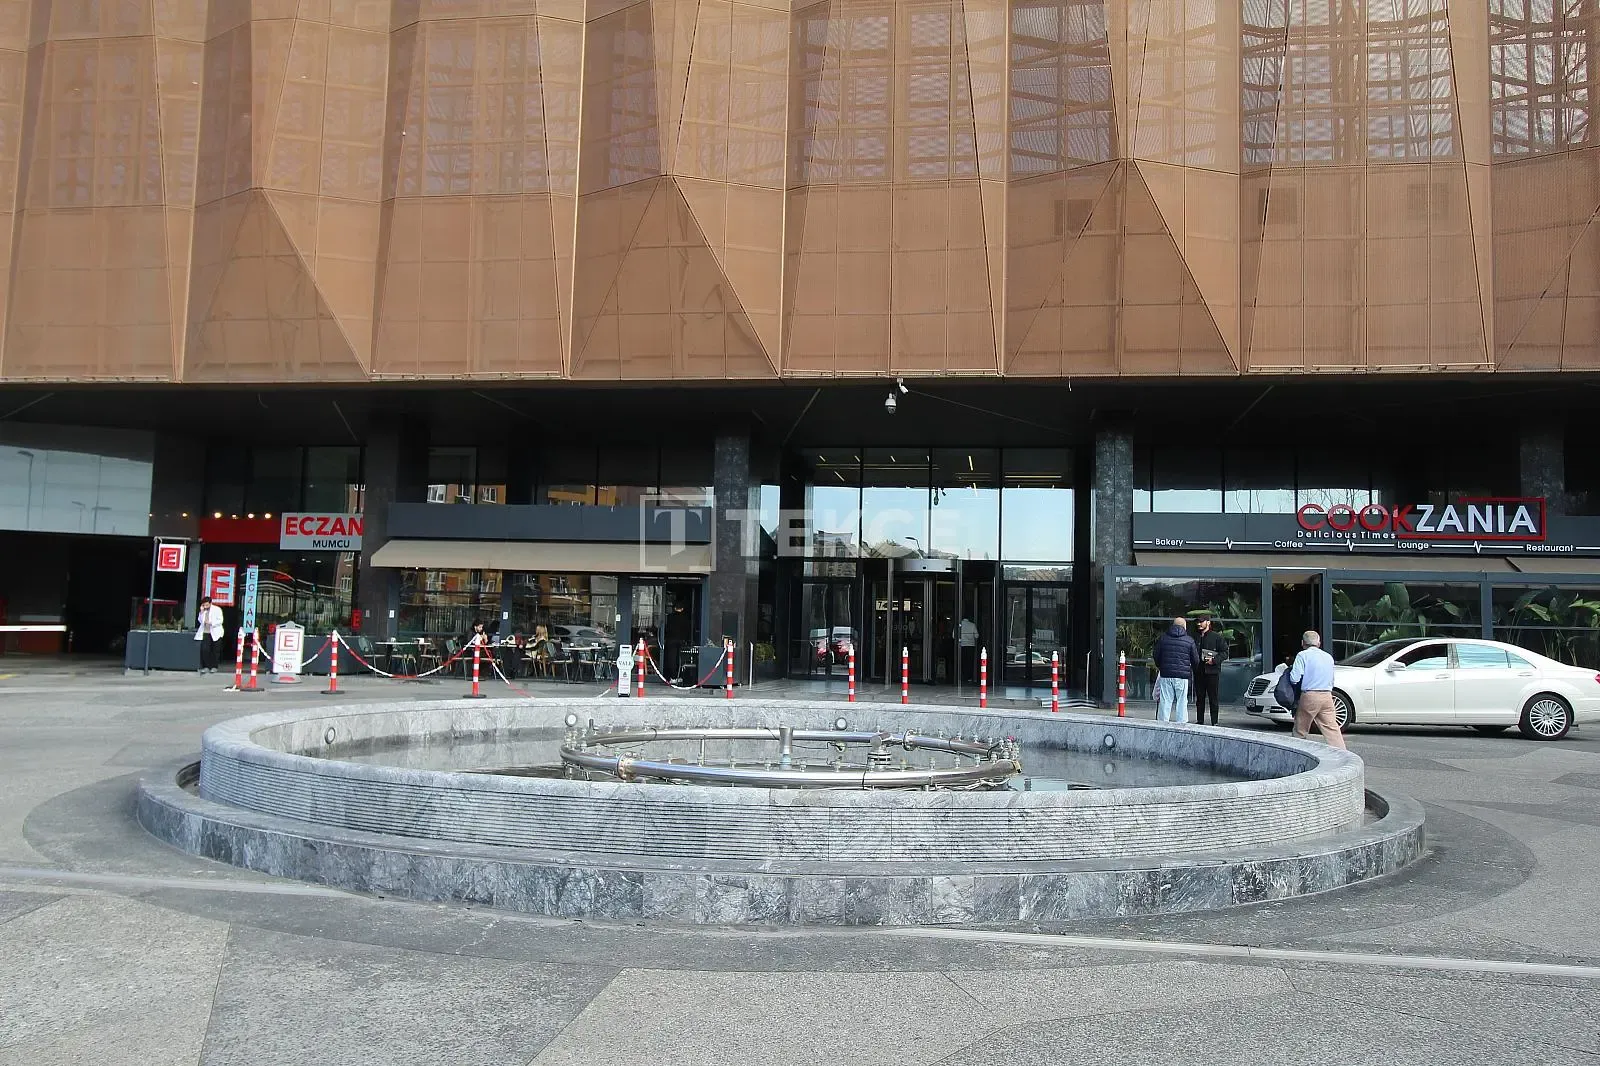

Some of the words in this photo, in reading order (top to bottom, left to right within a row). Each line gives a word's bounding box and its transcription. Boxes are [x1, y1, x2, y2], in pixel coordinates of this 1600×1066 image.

[286, 516, 364, 536] ECZAN
[1297, 503, 1537, 533] COOKZANIA
[312, 539, 350, 548] MUMCU
[1297, 531, 1357, 539] Delicious
[1361, 531, 1396, 540] Times
[1155, 538, 1184, 547] Bakery
[1274, 540, 1303, 548] Coffee
[1397, 541, 1429, 550] Lounge
[1526, 543, 1573, 552] Restaurant
[211, 569, 231, 600] E
[246, 572, 256, 627] ECZAN
[284, 635, 295, 648] E
